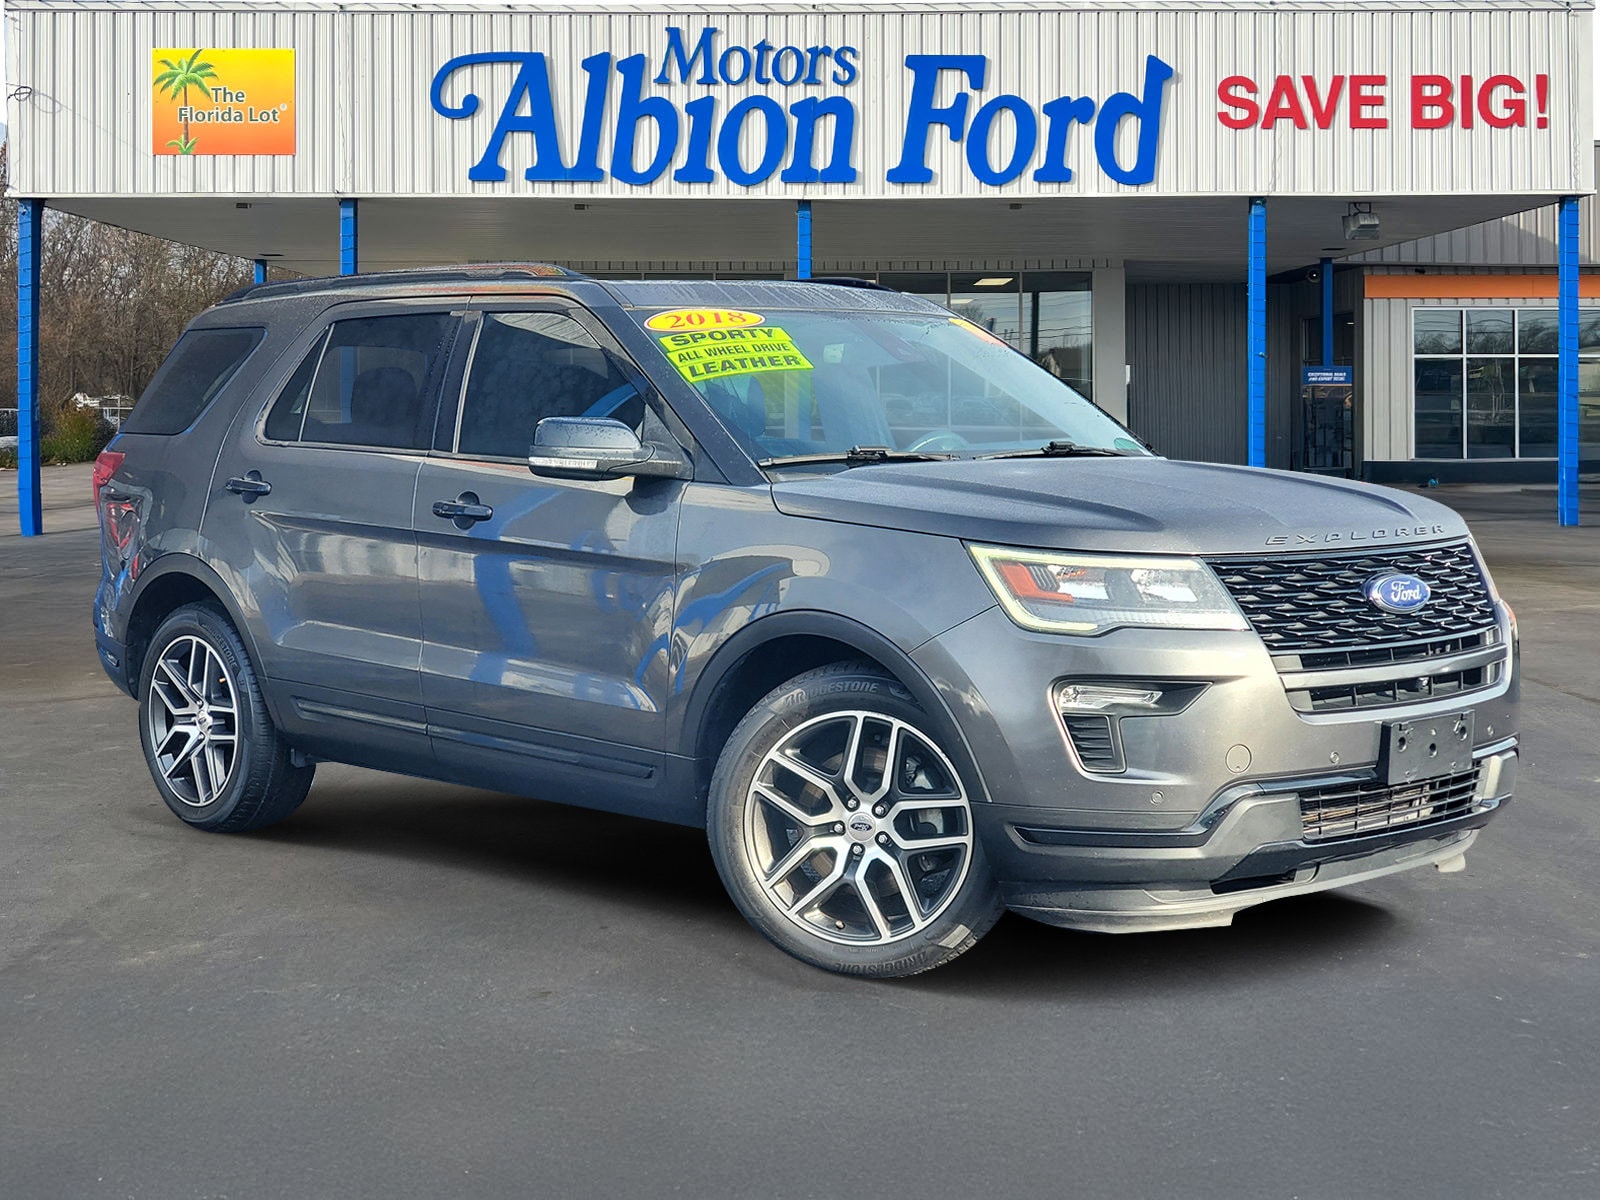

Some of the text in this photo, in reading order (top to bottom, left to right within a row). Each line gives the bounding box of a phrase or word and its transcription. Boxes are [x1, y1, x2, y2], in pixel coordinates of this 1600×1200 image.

[653, 26, 857, 86] Motors
[211, 87, 245, 102] The
[1217, 74, 1548, 129] SAVE BIG!
[178, 107, 279, 122] Florida Lot
[430, 51, 1174, 187] Albion Ford
[665, 312, 747, 328] 2018
[671, 327, 773, 347] SPORTY
[678, 342, 791, 363] ALL WHEEL DRIVE
[688, 354, 800, 378] LEATHER
[1265, 524, 1446, 546] EXPLORER
[1390, 580, 1423, 602] Ford
